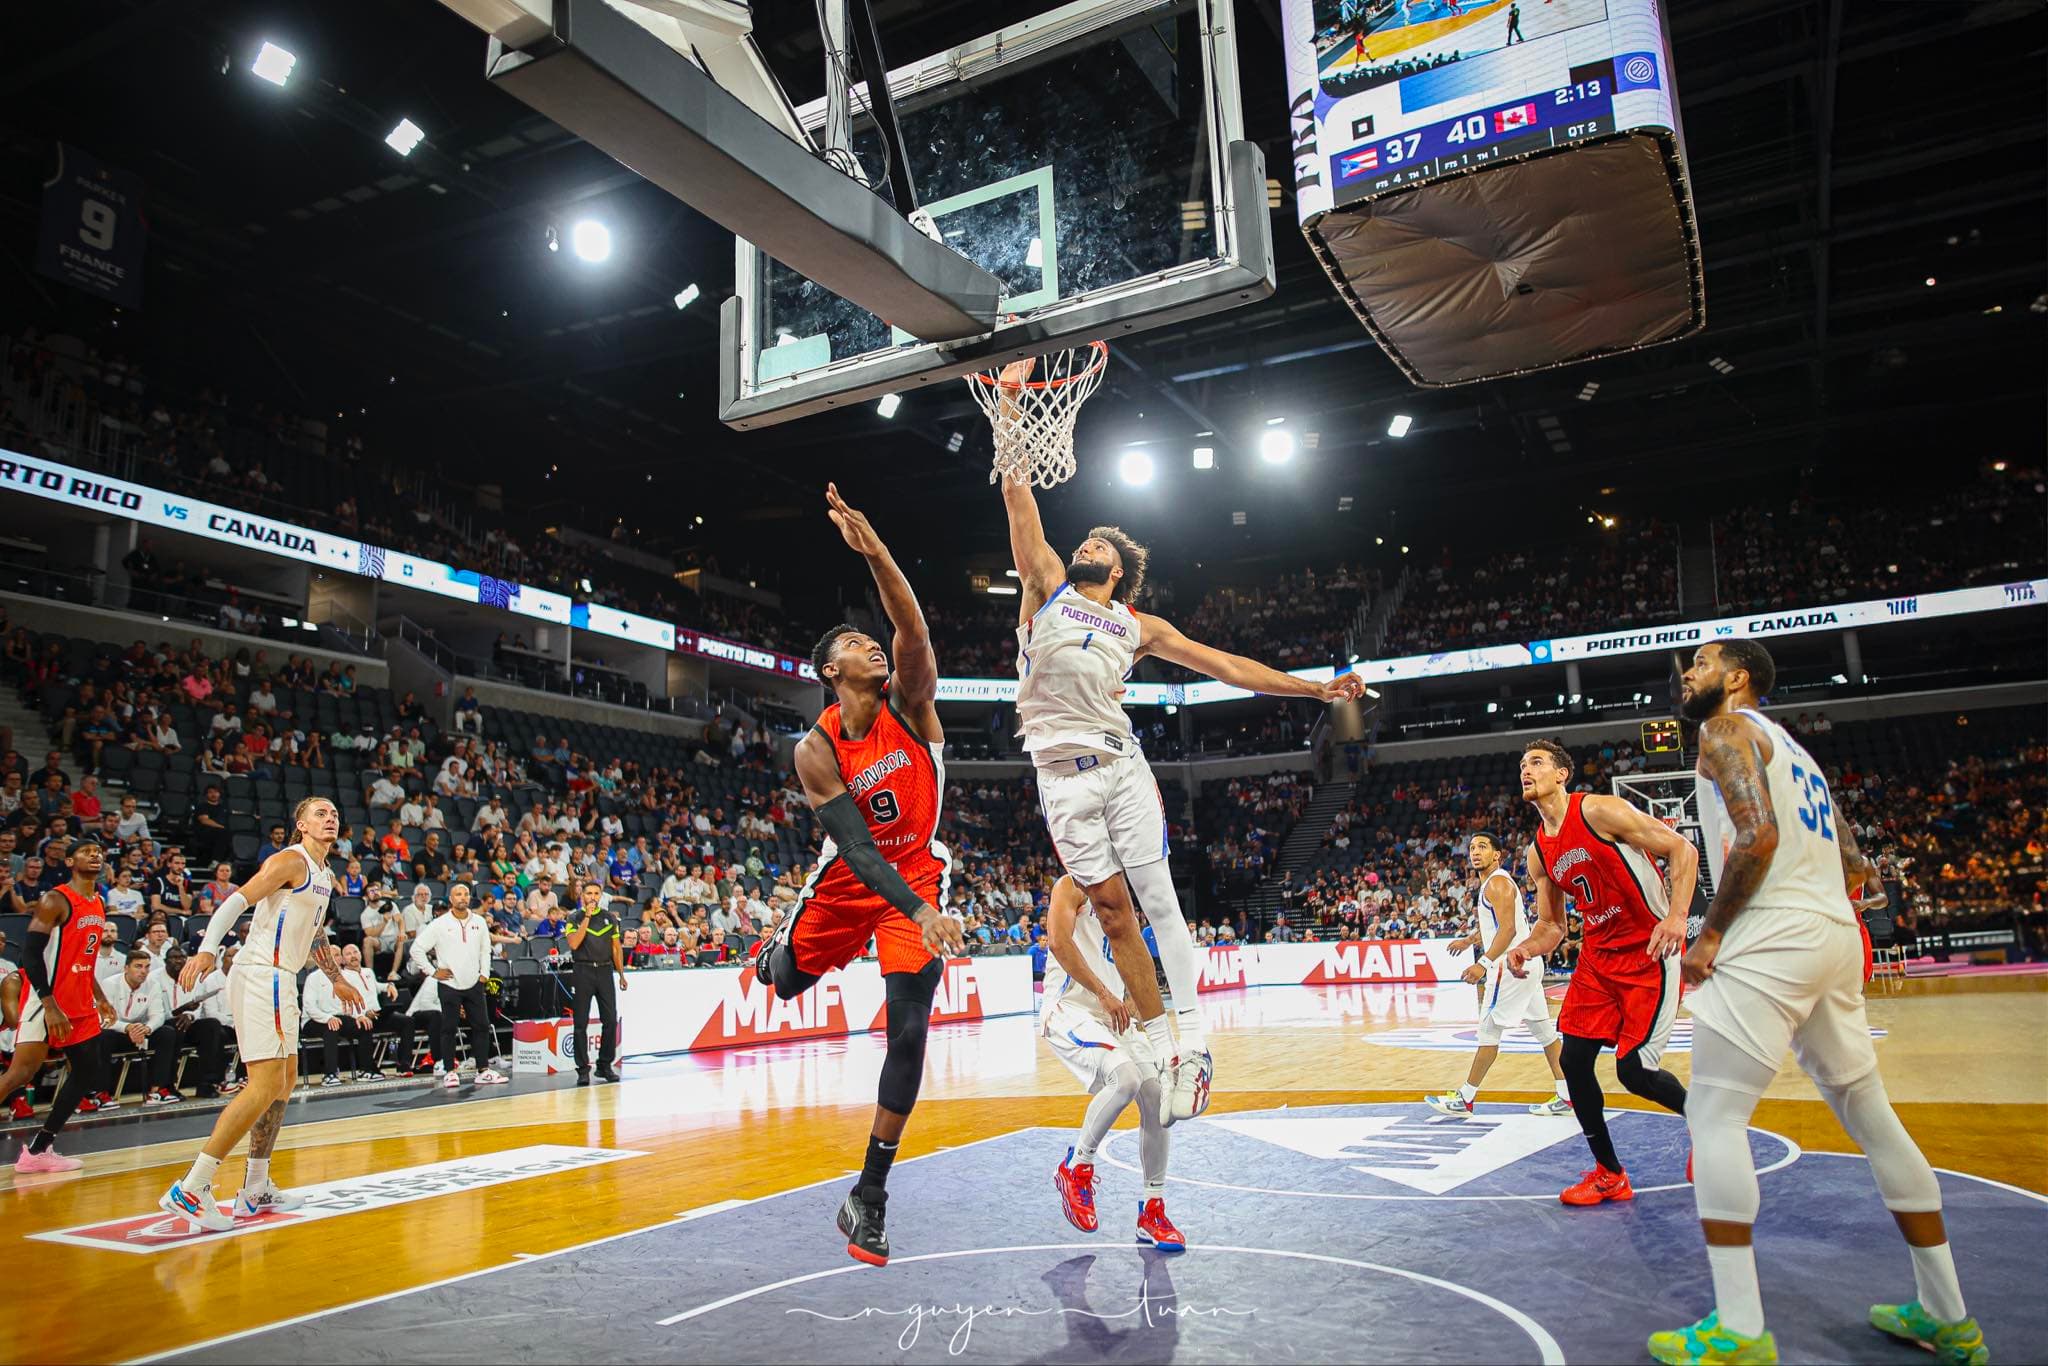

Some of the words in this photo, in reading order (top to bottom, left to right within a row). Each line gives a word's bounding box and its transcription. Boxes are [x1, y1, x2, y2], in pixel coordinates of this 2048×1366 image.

[1555, 80, 1601, 105] 2:13
[1385, 133, 1422, 165] 37
[1446, 116, 1486, 145] 40
[1568, 124, 1584, 137] QT
[1588, 121, 1597, 133] 2
[1462, 154, 1468, 164] 1
[1492, 146, 1499, 157] 1
[1393, 173, 1402, 183] 4
[1423, 165, 1430, 175] 1
[79, 198, 116, 250] 9
[59, 243, 128, 279] FRANCE
[69, 477, 142, 510] RICO
[163, 503, 188, 520] VS
[208, 513, 318, 555] CANADA
[1061, 605, 1101, 628] PUERTO
[1102, 619, 1127, 638] RICO
[1586, 634, 1651, 652] PORTO
[1656, 628, 1700, 644] RICO
[1716, 625, 1733, 636] VS
[1749, 611, 1838, 633] CANADA
[698, 637, 744, 662] PORTO
[745, 649, 775, 669] RICO
[798, 662, 819, 680] CA
[1082, 632, 1094, 650] 1
[847, 749, 912, 797] CANADA
[869, 789, 900, 824] 9
[1791, 762, 1834, 842] 32
[873, 837, 893, 847] un
[895, 832, 918, 846] Life
[1552, 847, 1593, 882] CANADA
[1571, 874, 1594, 904] 7
[313, 905, 323, 927] 0
[84, 932, 98, 955] 2
[1322, 943, 1428, 979] MAIF
[721, 969, 843, 1037] MAIF
[303, 1166, 492, 1206] CAISSE
